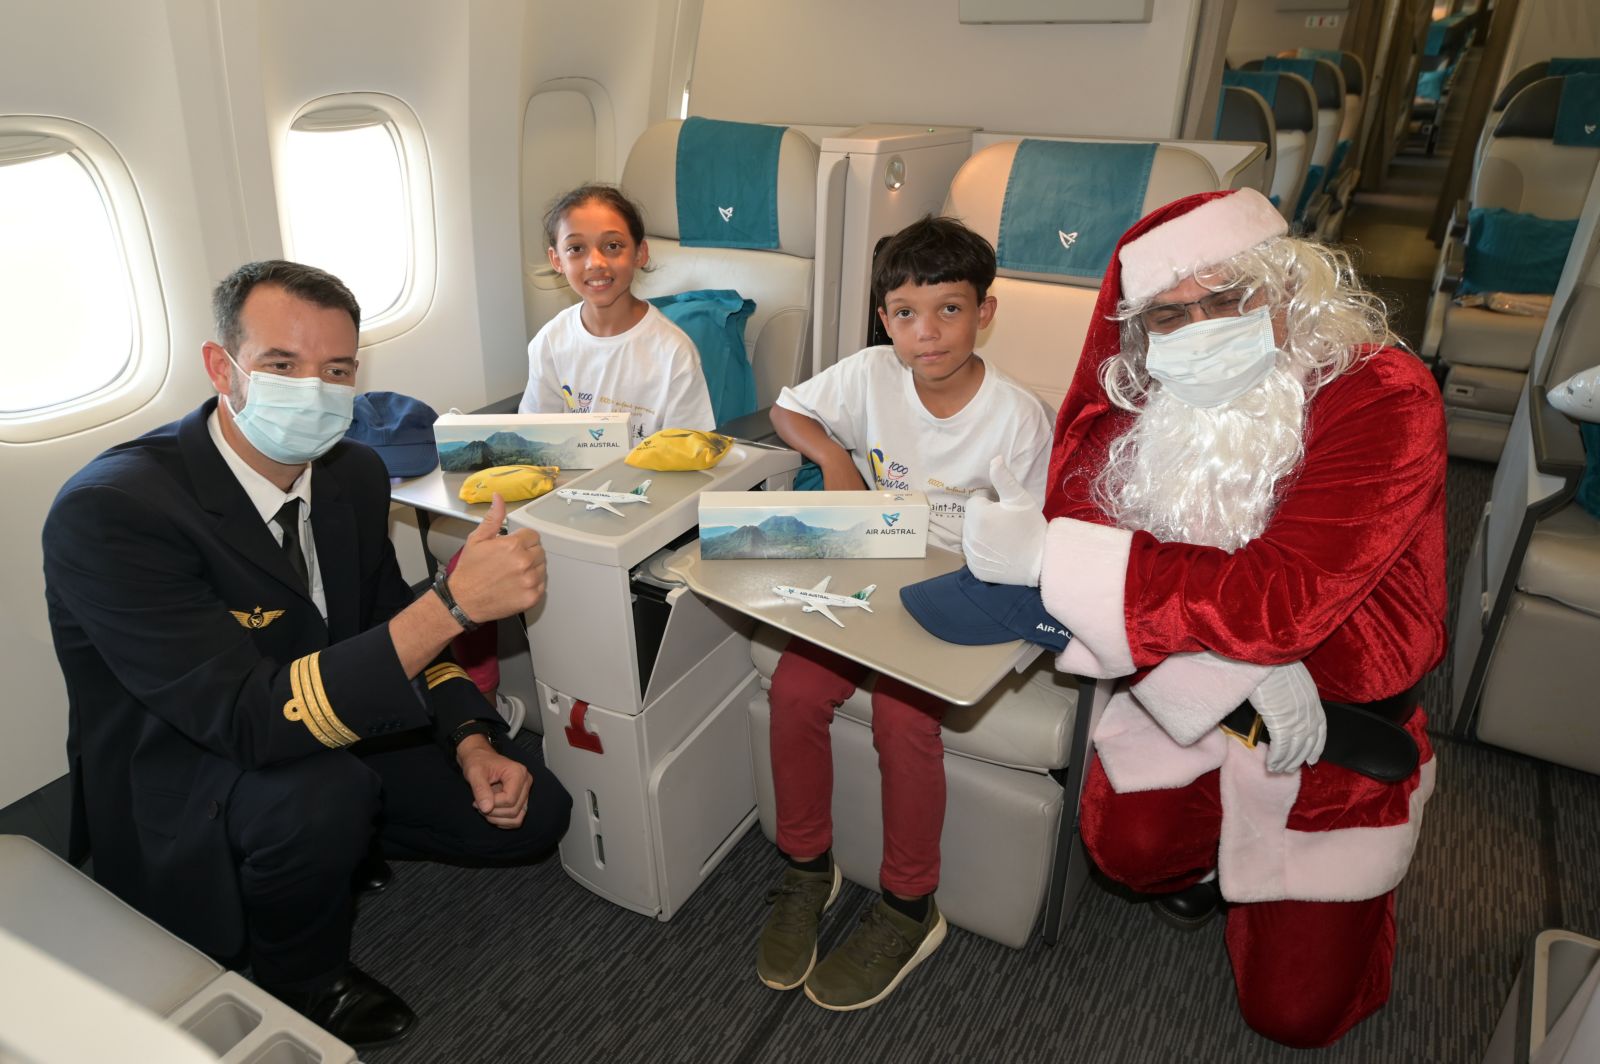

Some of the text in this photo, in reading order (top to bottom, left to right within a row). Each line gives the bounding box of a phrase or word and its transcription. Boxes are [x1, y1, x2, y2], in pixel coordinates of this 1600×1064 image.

[889, 461, 909, 475] 1000
[931, 502, 966, 513] aint-Pau
[1036, 622, 1056, 633] AIR
